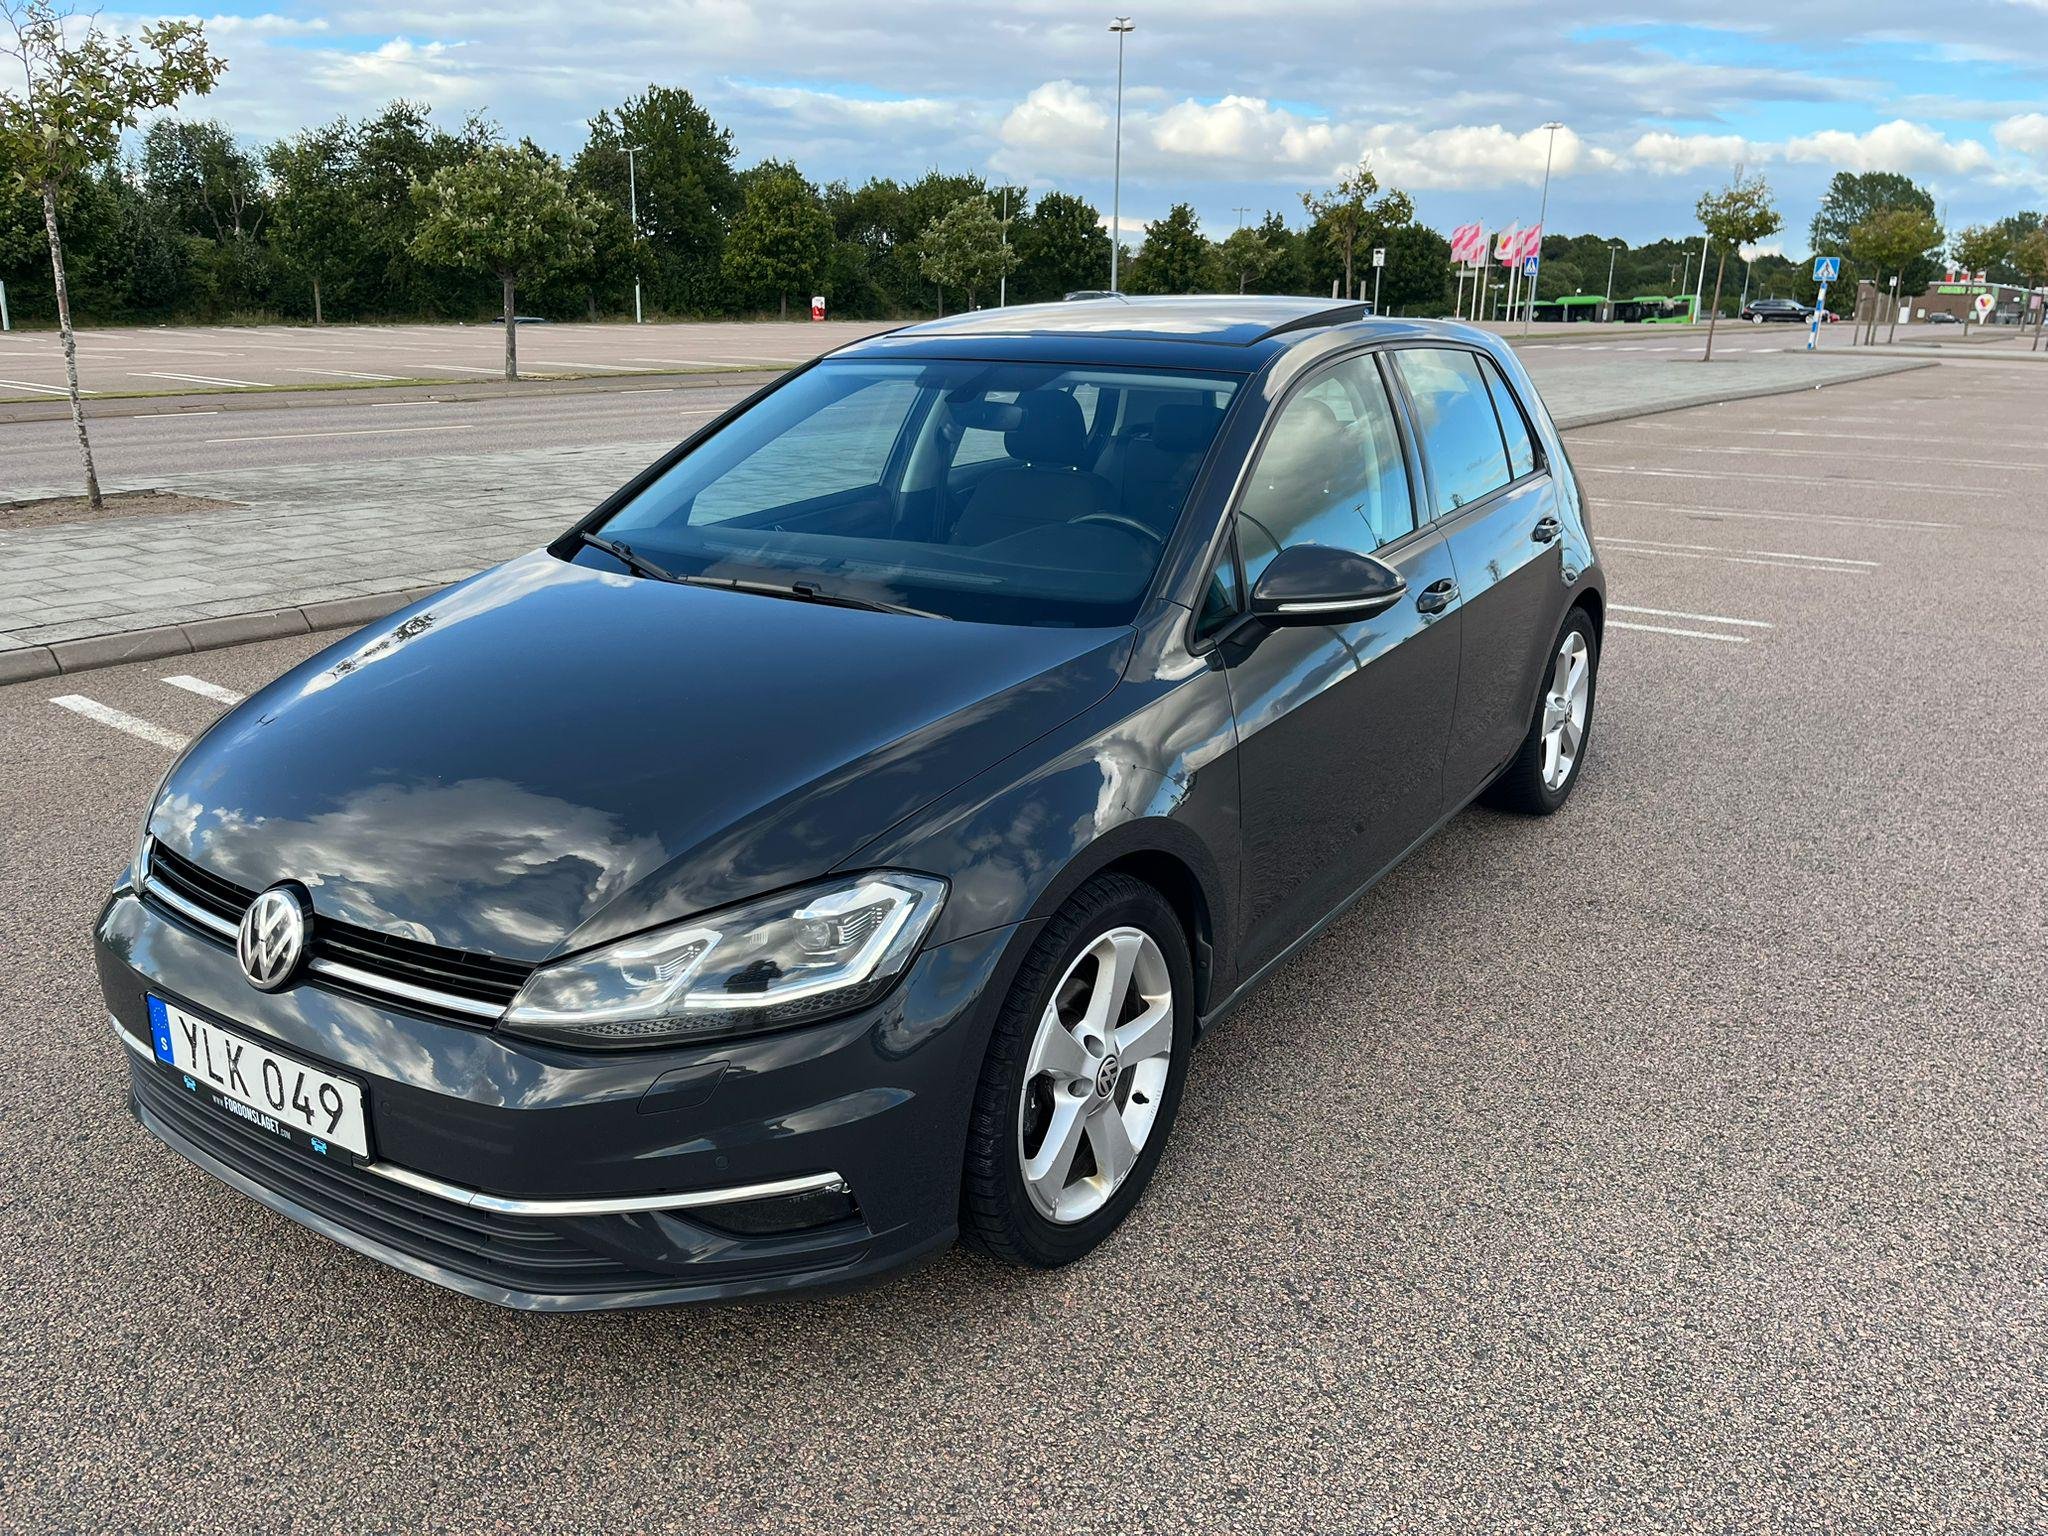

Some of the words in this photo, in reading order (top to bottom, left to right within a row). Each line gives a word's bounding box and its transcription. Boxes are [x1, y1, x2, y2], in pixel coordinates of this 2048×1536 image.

[160, 1036, 169, 1051] S
[178, 1015, 251, 1099] YLK
[262, 1057, 344, 1135] 049
